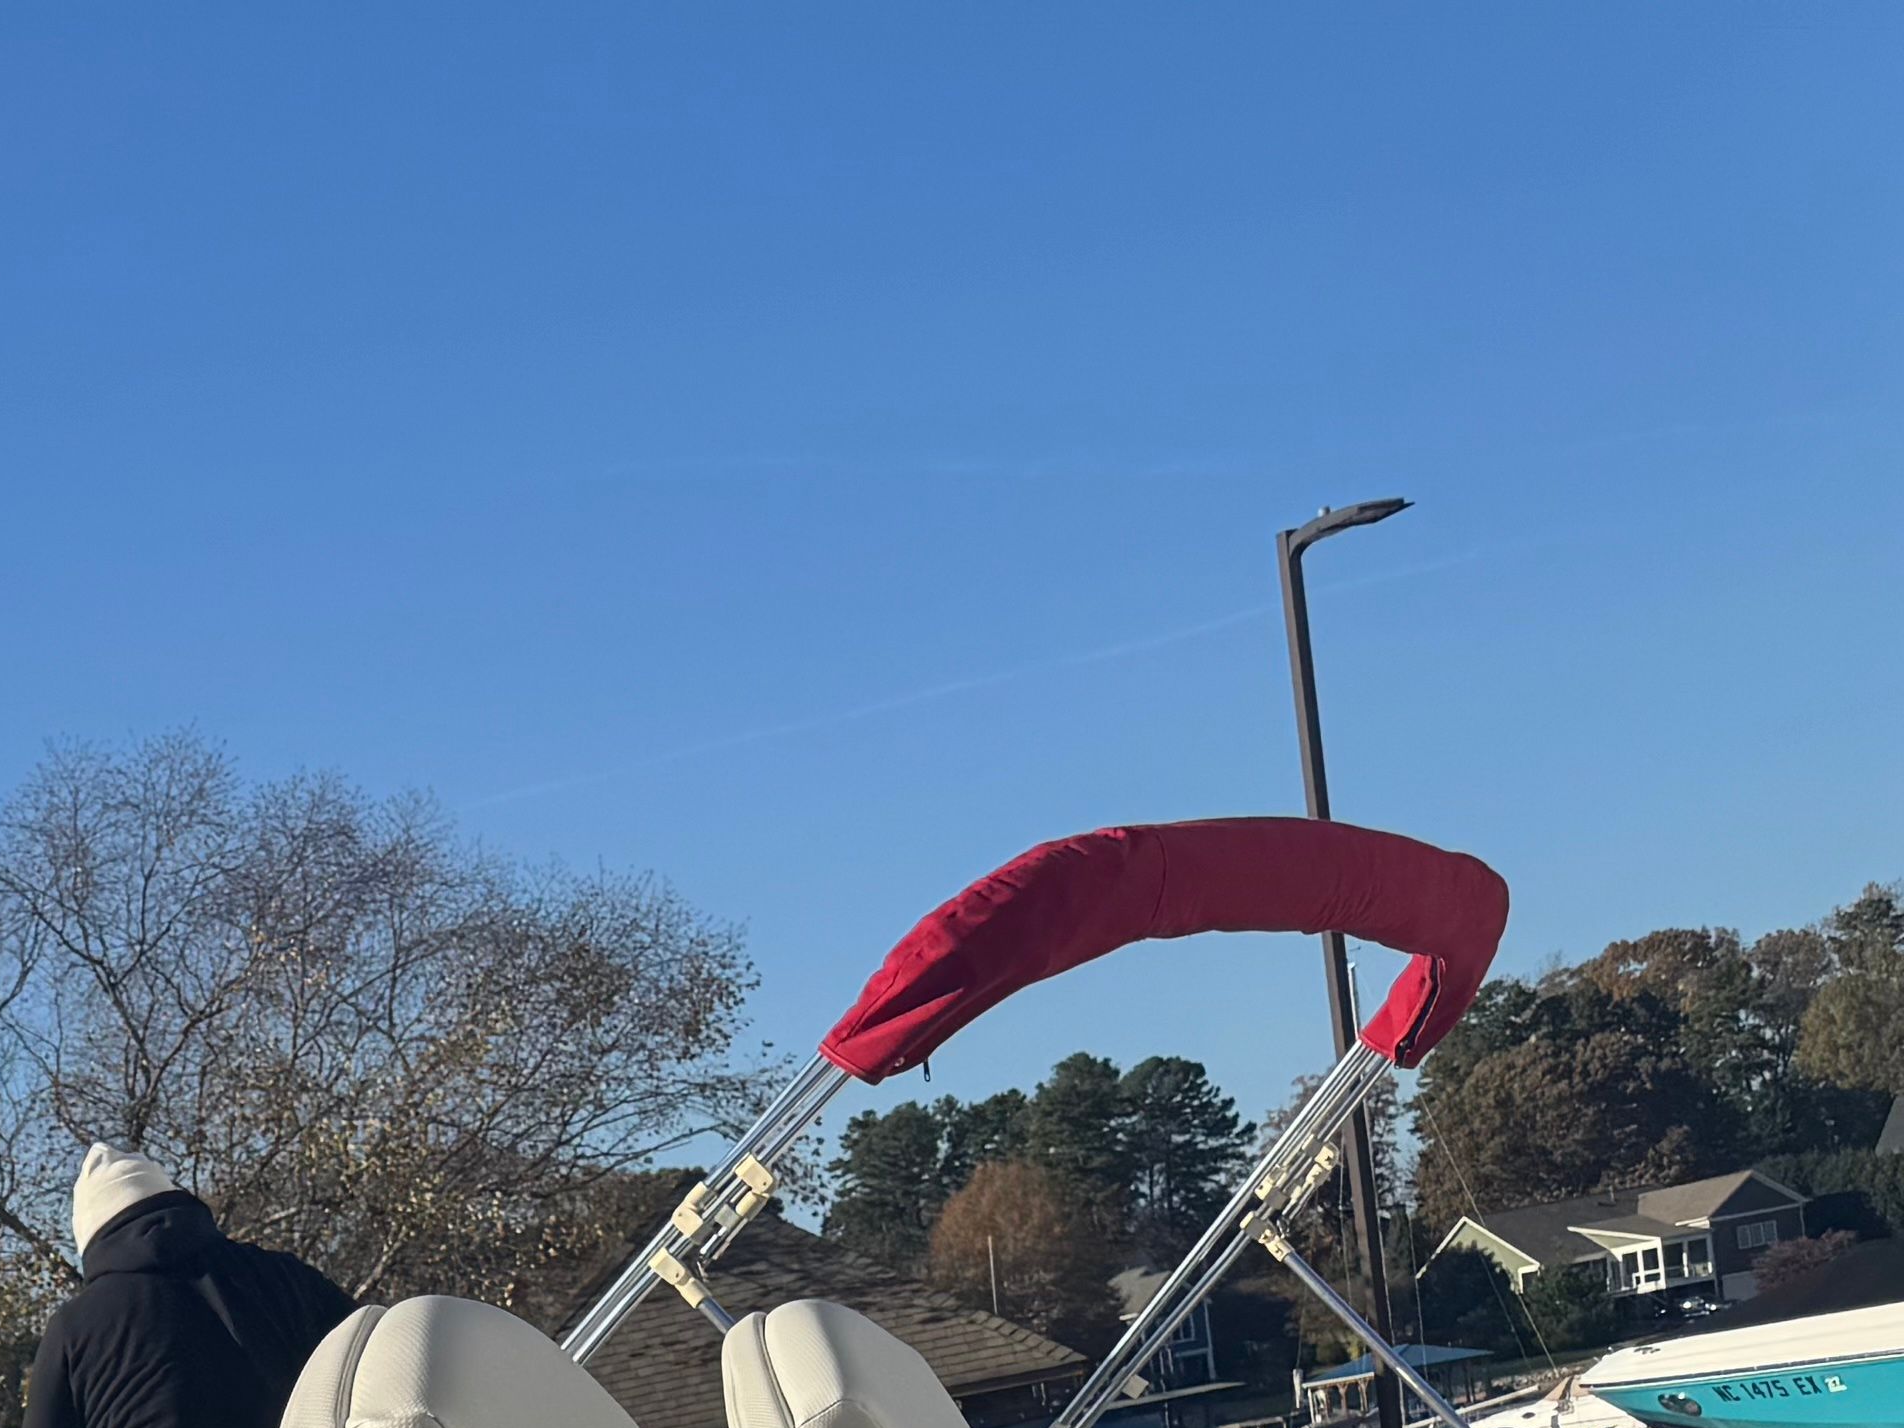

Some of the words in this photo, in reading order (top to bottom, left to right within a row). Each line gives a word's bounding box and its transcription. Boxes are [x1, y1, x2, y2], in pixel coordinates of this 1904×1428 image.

[1712, 1384, 1741, 1402] NC
[1740, 1379, 1790, 1400] 1475
[1792, 1376, 1822, 1396] EX
